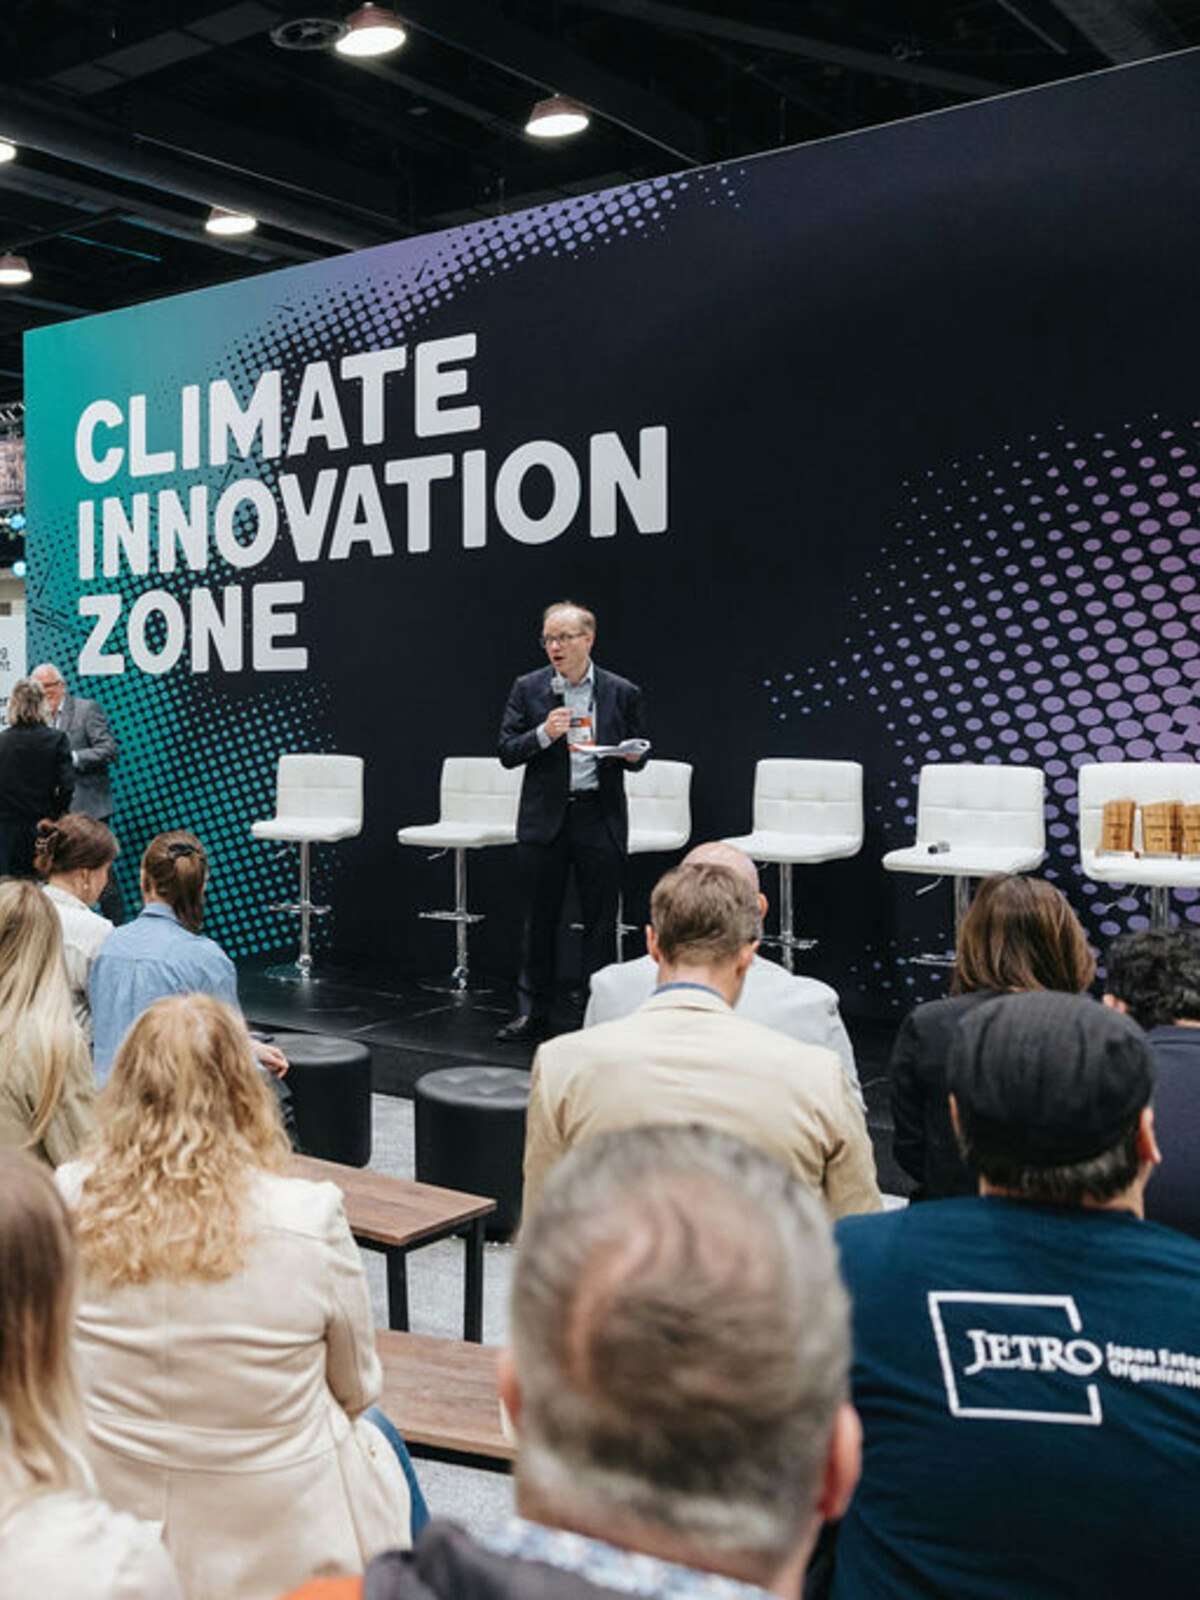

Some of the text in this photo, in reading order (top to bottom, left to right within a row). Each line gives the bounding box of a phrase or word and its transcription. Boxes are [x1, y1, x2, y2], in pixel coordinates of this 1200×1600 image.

[75, 333, 481, 483] CLIMATE
[78, 426, 668, 580] INNOVATION
[78, 580, 308, 676] ZONE
[964, 1329, 1102, 1376] JETRO
[1106, 1342, 1156, 1363] Japan
